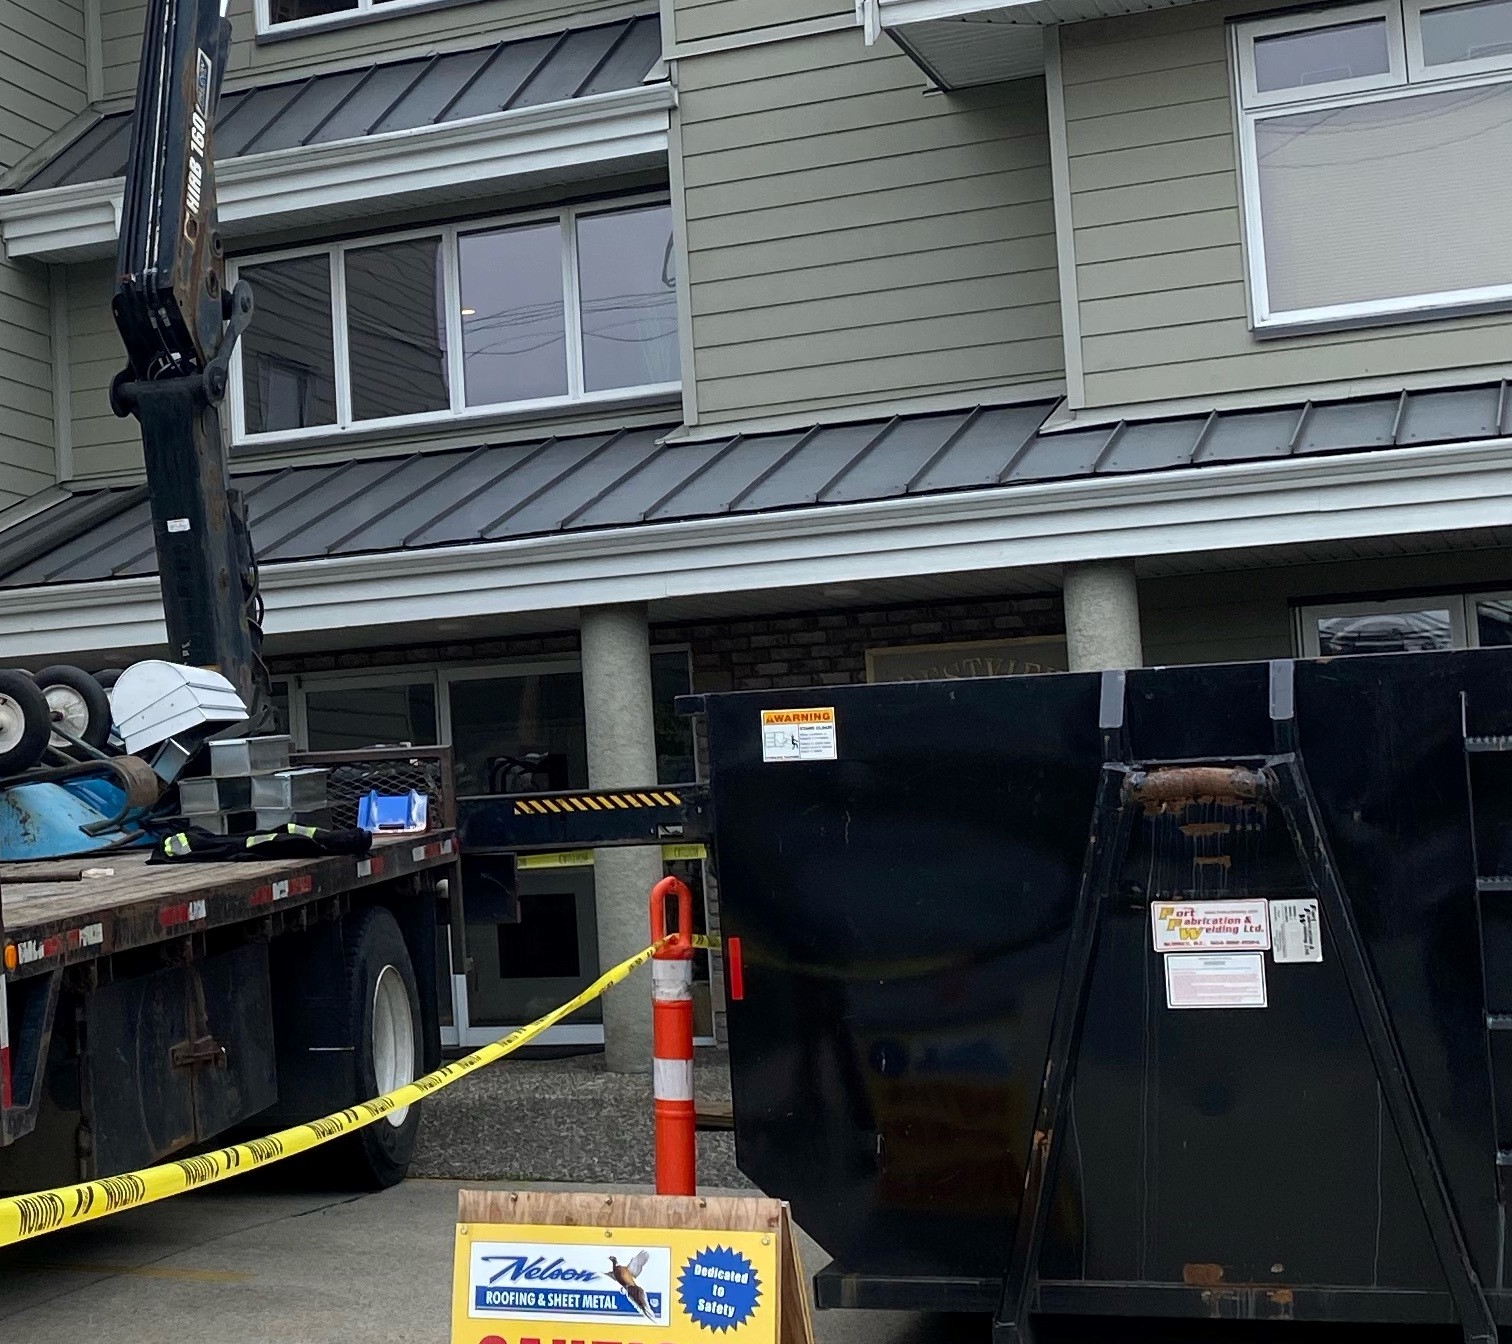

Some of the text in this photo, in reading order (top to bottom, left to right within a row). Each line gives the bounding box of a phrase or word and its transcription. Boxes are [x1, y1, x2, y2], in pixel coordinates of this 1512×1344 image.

[191, 112, 206, 157] 160
[186, 156, 203, 214] HIAB
[774, 712, 831, 723] WARNING
[481, 1256, 603, 1286] Nelson
[693, 1264, 749, 1285] Dedicated
[486, 1290, 617, 1309] ROOFING & SHEET METAL
[712, 1284, 725, 1298] to
[697, 1298, 736, 1318] Safety
